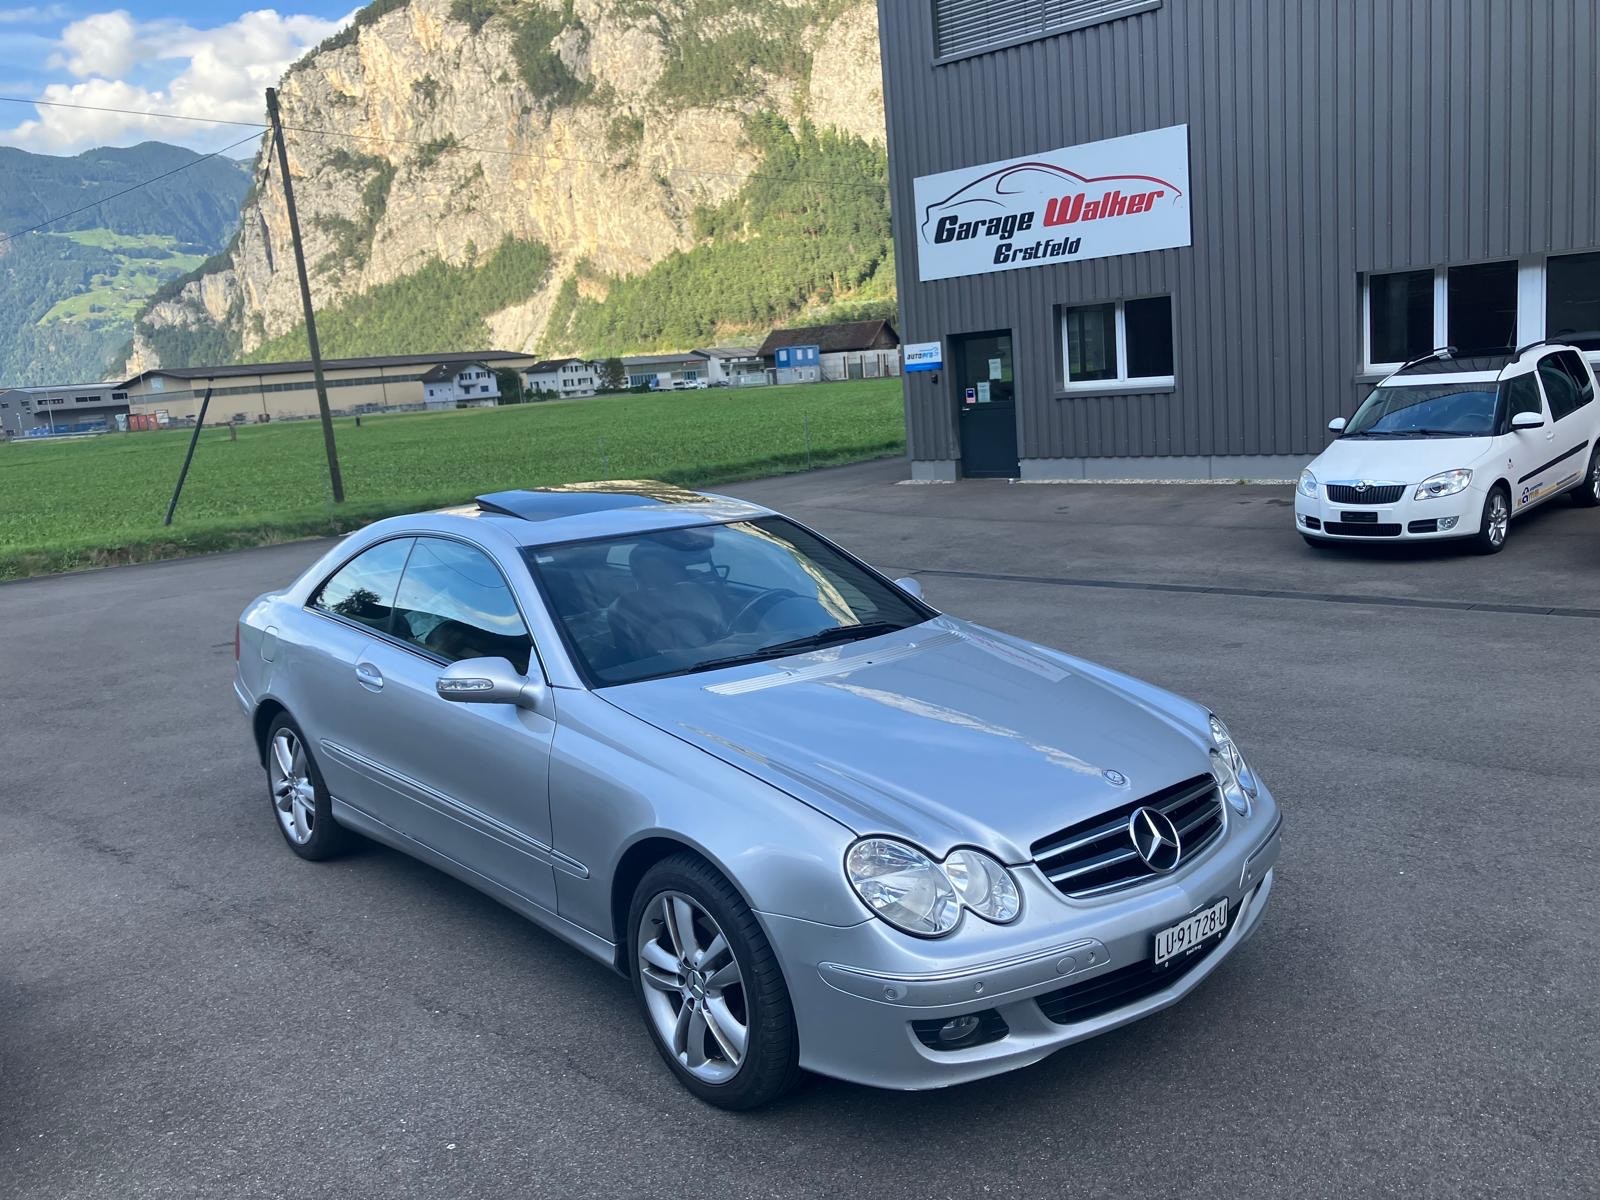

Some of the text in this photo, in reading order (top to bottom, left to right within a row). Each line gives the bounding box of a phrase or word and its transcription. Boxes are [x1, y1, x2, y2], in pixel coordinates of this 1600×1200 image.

[934, 190, 1164, 244] Garage Walker
[993, 237, 1081, 264] Erstfeld
